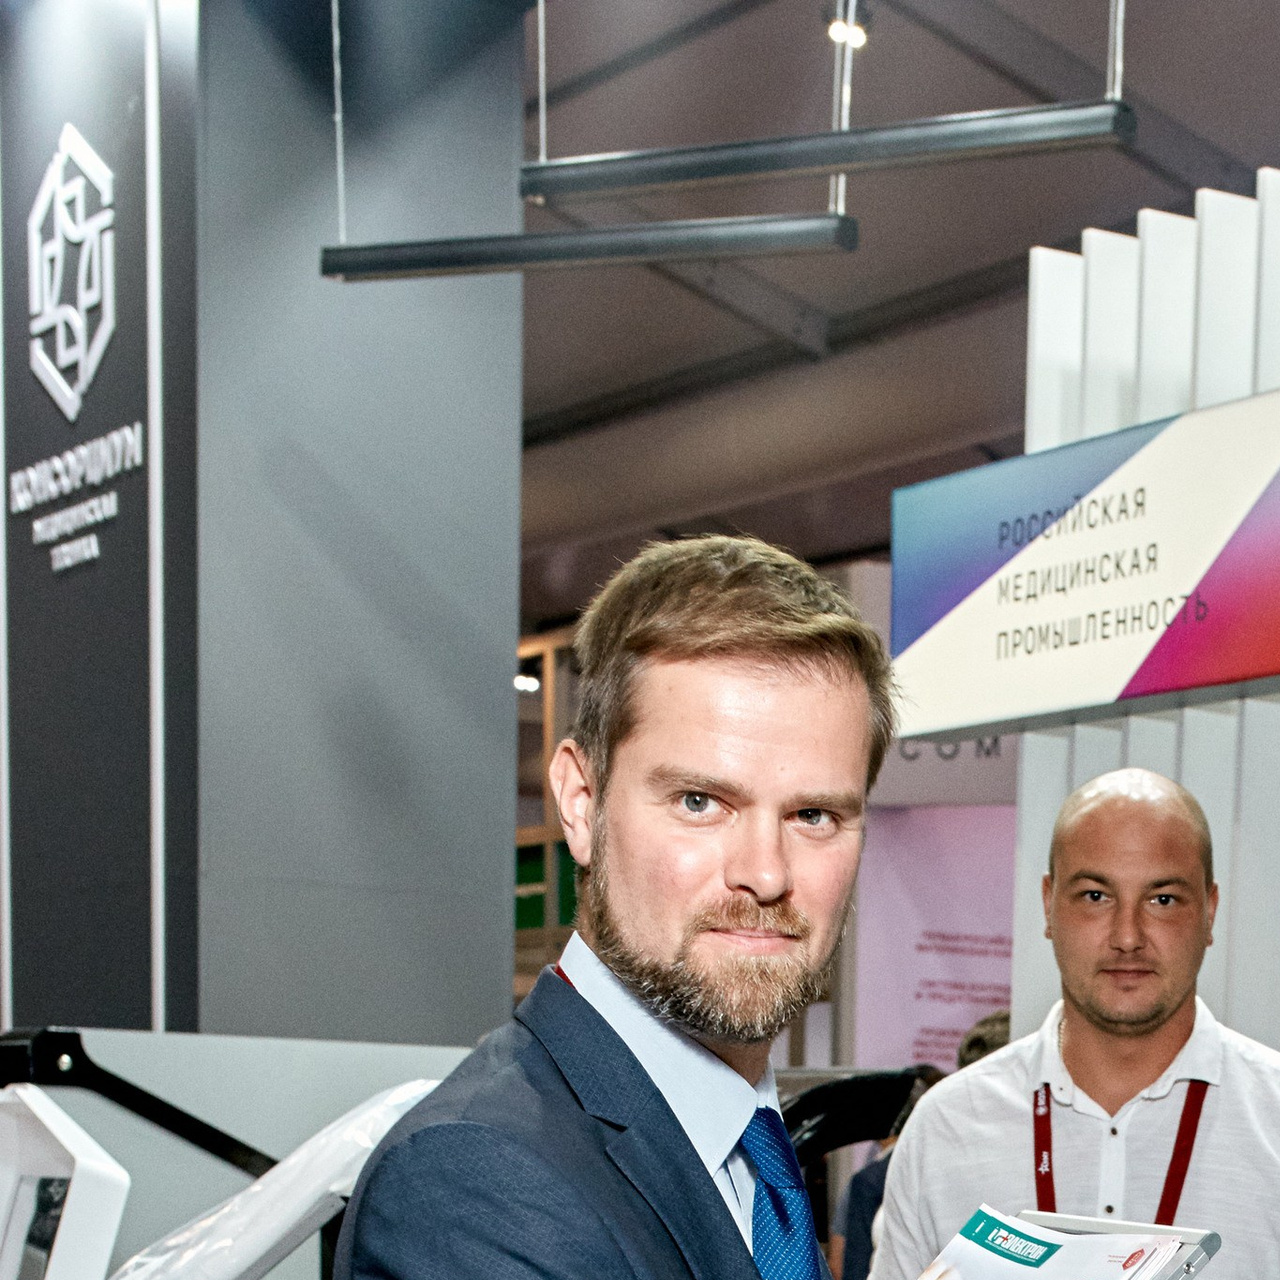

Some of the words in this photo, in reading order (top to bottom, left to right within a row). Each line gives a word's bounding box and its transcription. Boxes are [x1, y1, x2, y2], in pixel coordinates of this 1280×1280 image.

[998, 487, 1146, 549] РОССИЙСКАЯ
[997, 542, 1158, 605] МЕДИЦИНСКАЯ
[996, 593, 1209, 660] ПРОМЫШЛЕННОСТЬ
